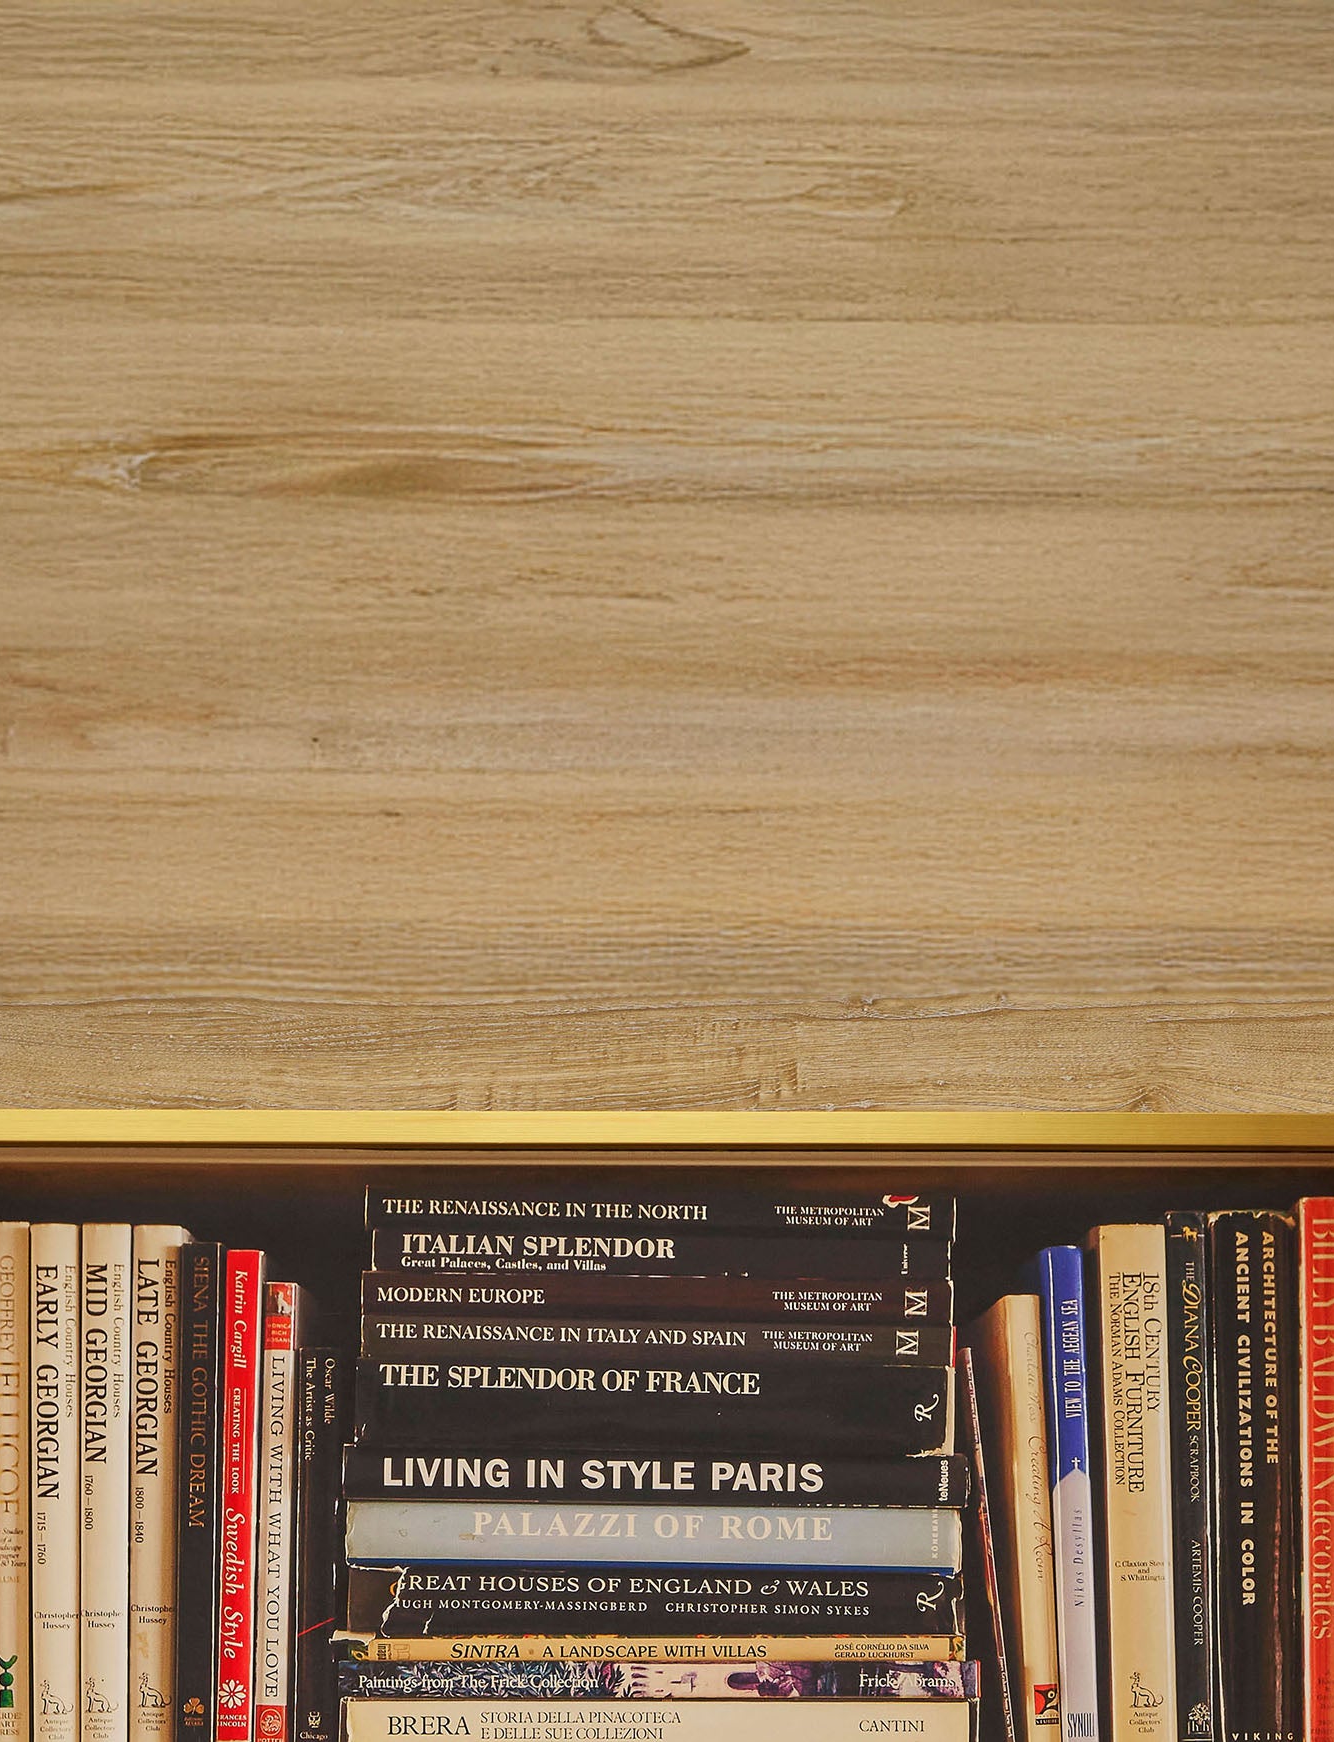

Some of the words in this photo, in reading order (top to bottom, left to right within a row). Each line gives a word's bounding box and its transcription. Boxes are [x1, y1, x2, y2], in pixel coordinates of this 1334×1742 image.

[382, 1199, 424, 1214] THE
[428, 1199, 561, 1217] RENAISSANCE
[565, 1202, 586, 1218] IN
[591, 1203, 633, 1219] THE
[638, 1204, 707, 1221] NORTH
[774, 1205, 796, 1215] THE
[800, 1206, 884, 1217] METROPOLITAN
[785, 1215, 832, 1226] MUSEUM
[834, 1217, 848, 1226] OF
[851, 1217, 871, 1226] ART
[402, 1233, 516, 1256] ITALIAN
[523, 1235, 676, 1259] SPLENDOR
[85, 1262, 108, 1317] MID
[1235, 1231, 1250, 1324] ANCIENT
[35, 1264, 59, 1350] EARLY
[377, 1286, 463, 1303] MODERN
[468, 1288, 545, 1304] EUROPE
[1060, 1299, 1079, 1316] SEA
[1062, 1320, 1080, 1355] AEGEAN
[379, 1363, 440, 1387] THE
[447, 1365, 597, 1391] SPLENDOR
[601, 1369, 640, 1392] OF
[645, 1370, 760, 1395] FRANCE
[1063, 1358, 1081, 1376] THE
[84, 1328, 108, 1464] GEORGIAN
[270, 1356, 285, 1437] LIVING
[1064, 1380, 1082, 1393] TO
[232, 1387, 241, 1438] CREATING
[1064, 1397, 1083, 1418] VIEW
[1237, 1334, 1254, 1488] CIVILIZATIONS
[36, 1364, 60, 1500] GEORGIAN
[232, 1442, 240, 1462] THE
[231, 1467, 240, 1494] LOOK
[268, 1443, 283, 1504] WITH
[383, 1457, 510, 1488] LIVING
[526, 1459, 564, 1489] IN
[580, 1459, 695, 1491] STYLE
[711, 1462, 824, 1493] PARIS
[472, 1511, 638, 1538] PALAZZI
[654, 1514, 704, 1539] OF
[719, 1515, 832, 1541] ROME
[1240, 1502, 1254, 1524] IN
[225, 1507, 246, 1595] Swedish
[267, 1512, 282, 1579] WHAT
[1241, 1538, 1256, 1606] COLOR
[266, 1585, 280, 1632] YOU
[665, 1602, 768, 1614] CHRISTOPHER
[774, 1604, 820, 1615] SIMON
[826, 1605, 870, 1616] SYKES
[222, 1606, 244, 1659] Style
[450, 1643, 520, 1659] SINTRA
[542, 1645, 554, 1658] A
[560, 1645, 658, 1658] LANDSCAPE
[664, 1645, 706, 1658] WITH
[712, 1645, 767, 1658] VILLAS
[265, 1638, 279, 1698] LOVE
[387, 1715, 471, 1736] BRERA
[859, 1720, 924, 1732] CANTINI
[1231, 1732, 1294, 1741] VIKING
